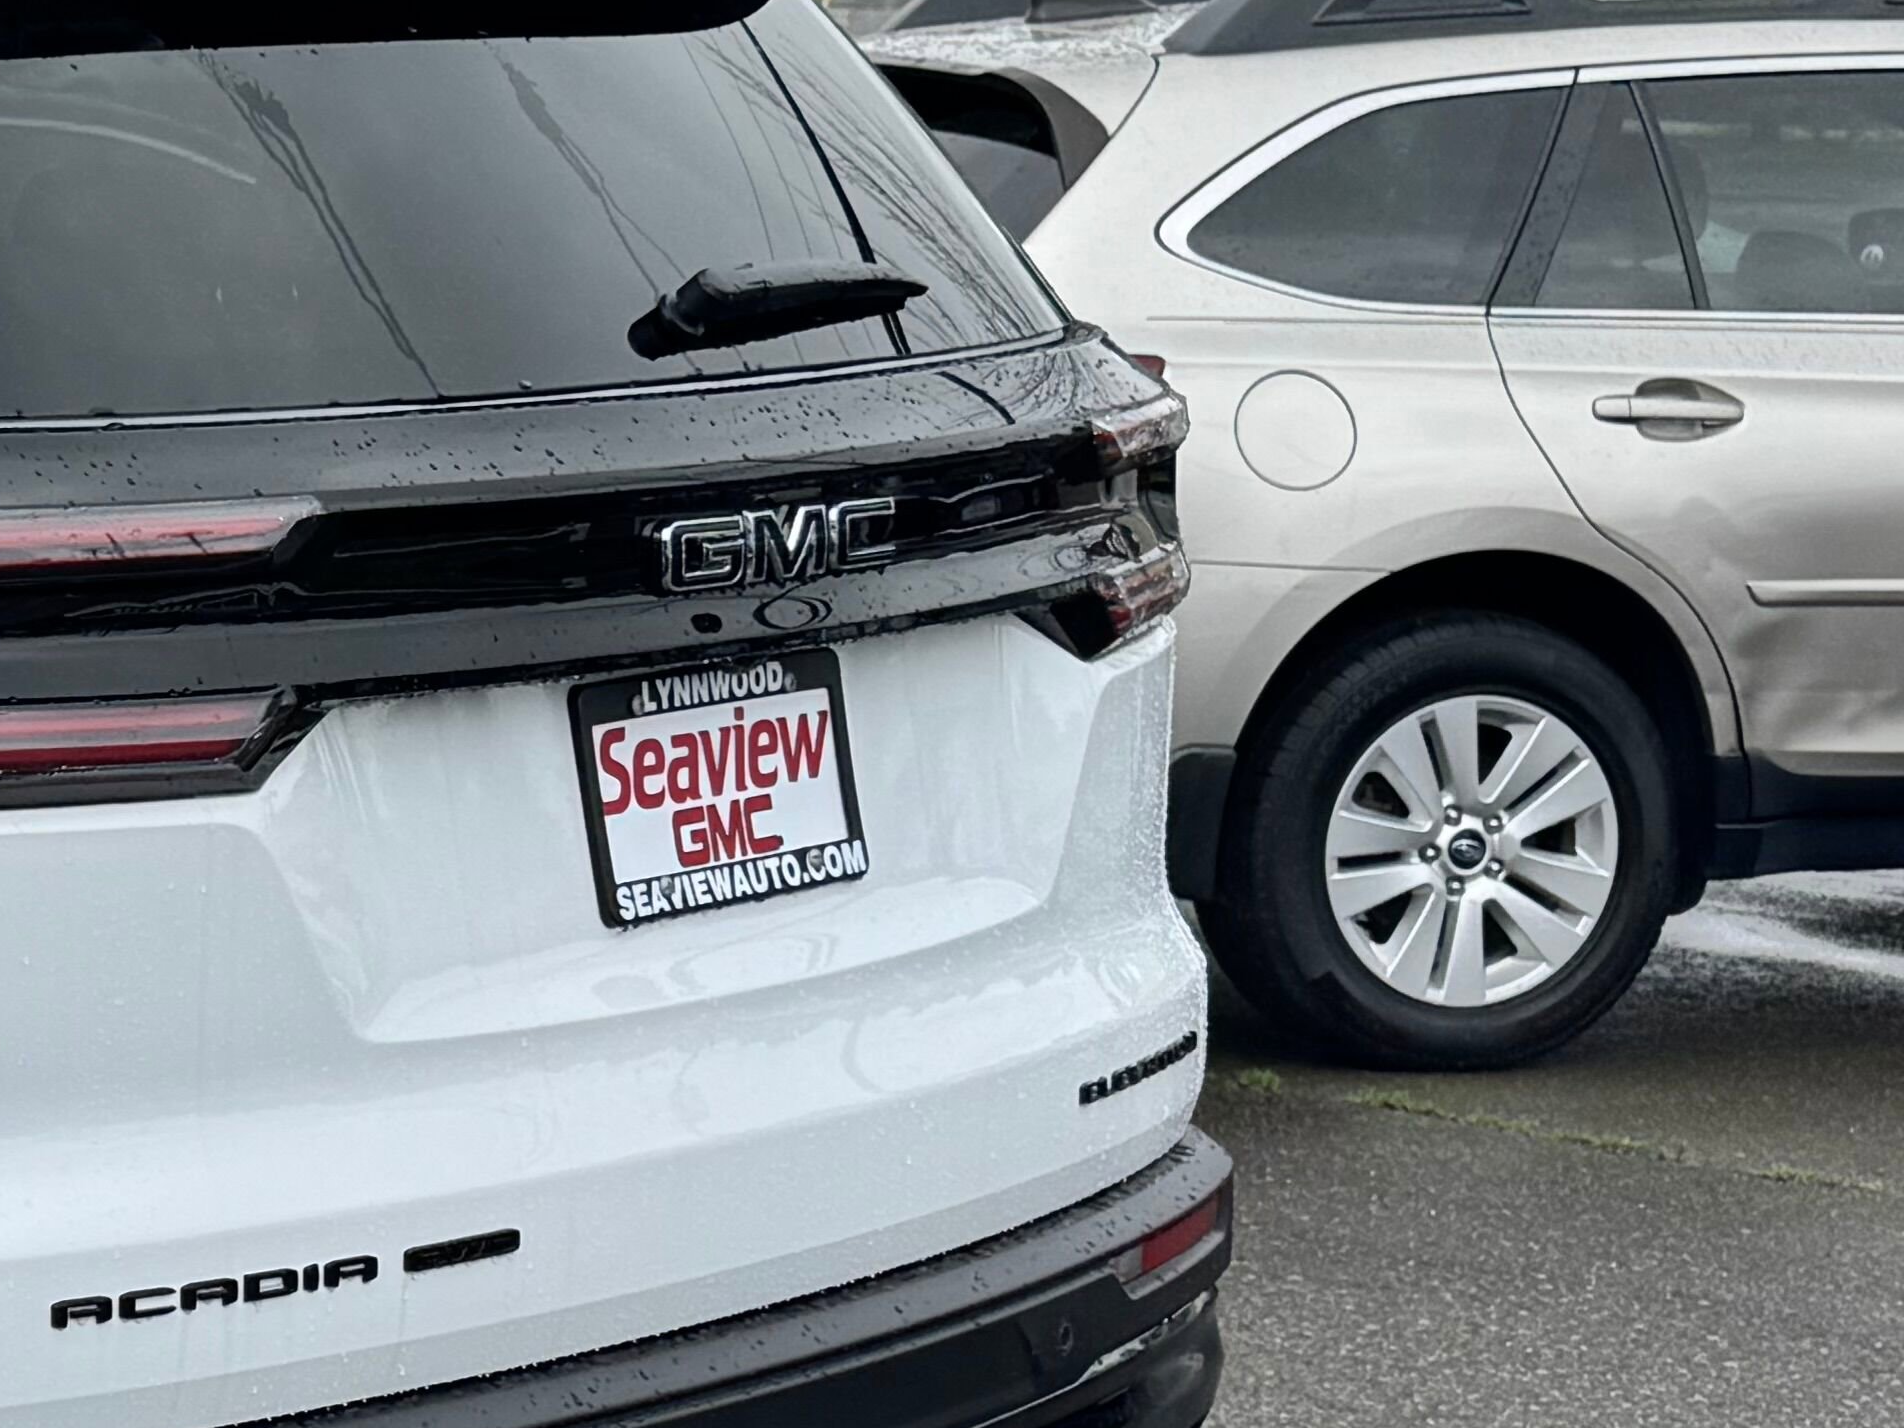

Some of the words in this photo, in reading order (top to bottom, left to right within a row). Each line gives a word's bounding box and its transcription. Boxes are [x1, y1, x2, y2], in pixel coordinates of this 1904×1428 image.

[662, 497, 896, 592] GMC
[641, 661, 784, 714] LYNNWOOD
[600, 706, 828, 816] Seaview
[672, 794, 784, 868] GMC
[50, 1254, 378, 1330] ACADIA
